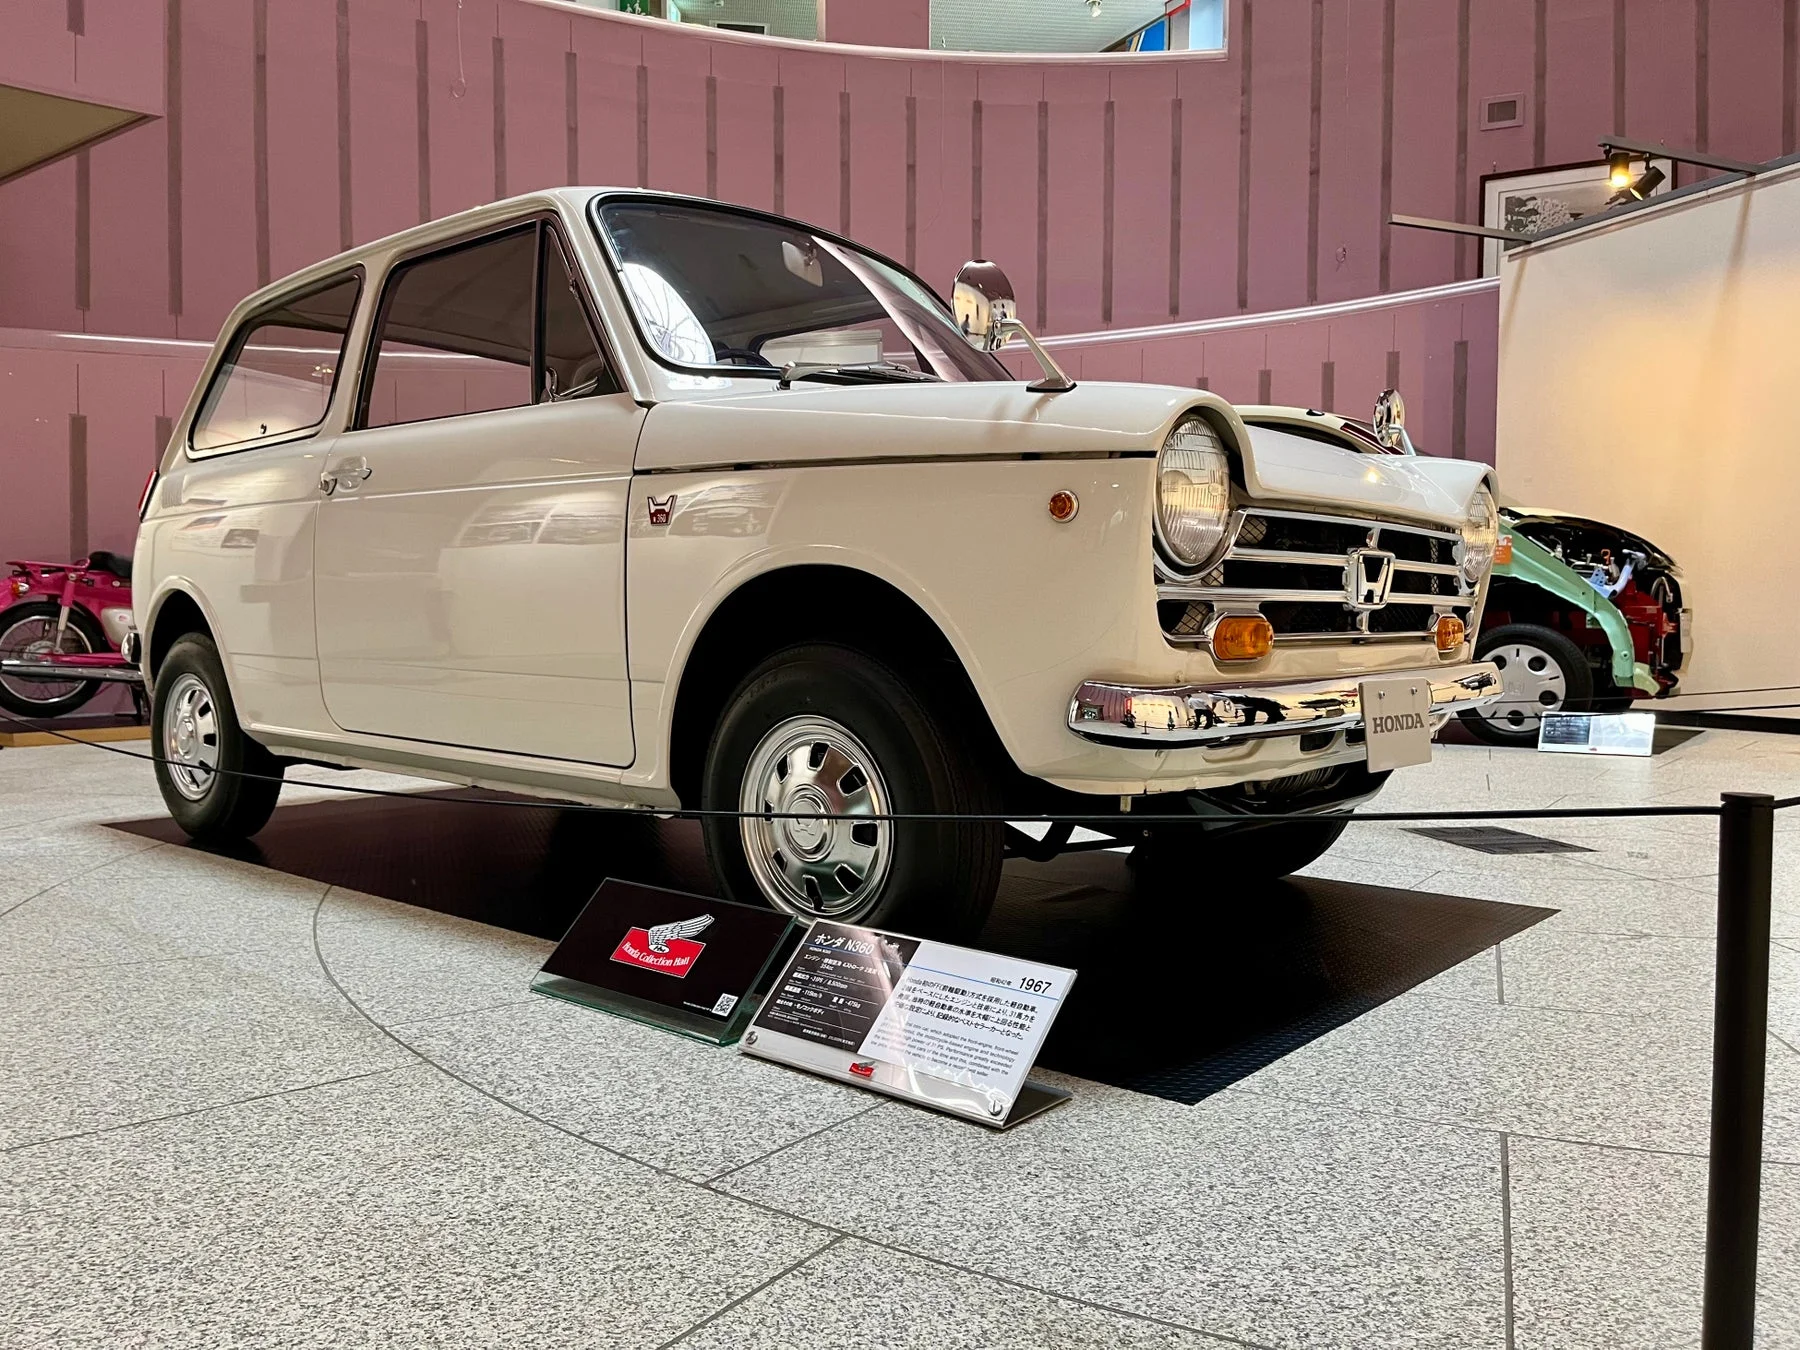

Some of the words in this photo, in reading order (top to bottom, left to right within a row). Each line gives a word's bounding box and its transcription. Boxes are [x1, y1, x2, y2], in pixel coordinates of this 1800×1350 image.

[1372, 713, 1425, 734] HONDA
[814, 934, 846, 948] ホンダ
[845, 940, 875, 954] N360
[622, 941, 640, 959] Honda
[639, 951, 673, 967] Collection
[673, 956, 690, 967] Hall
[1019, 978, 1052, 993] 1967
[969, 1061, 990, 1069] combined
[990, 1053, 1015, 1062] technology
[991, 1060, 1012, 1068] exceeded
